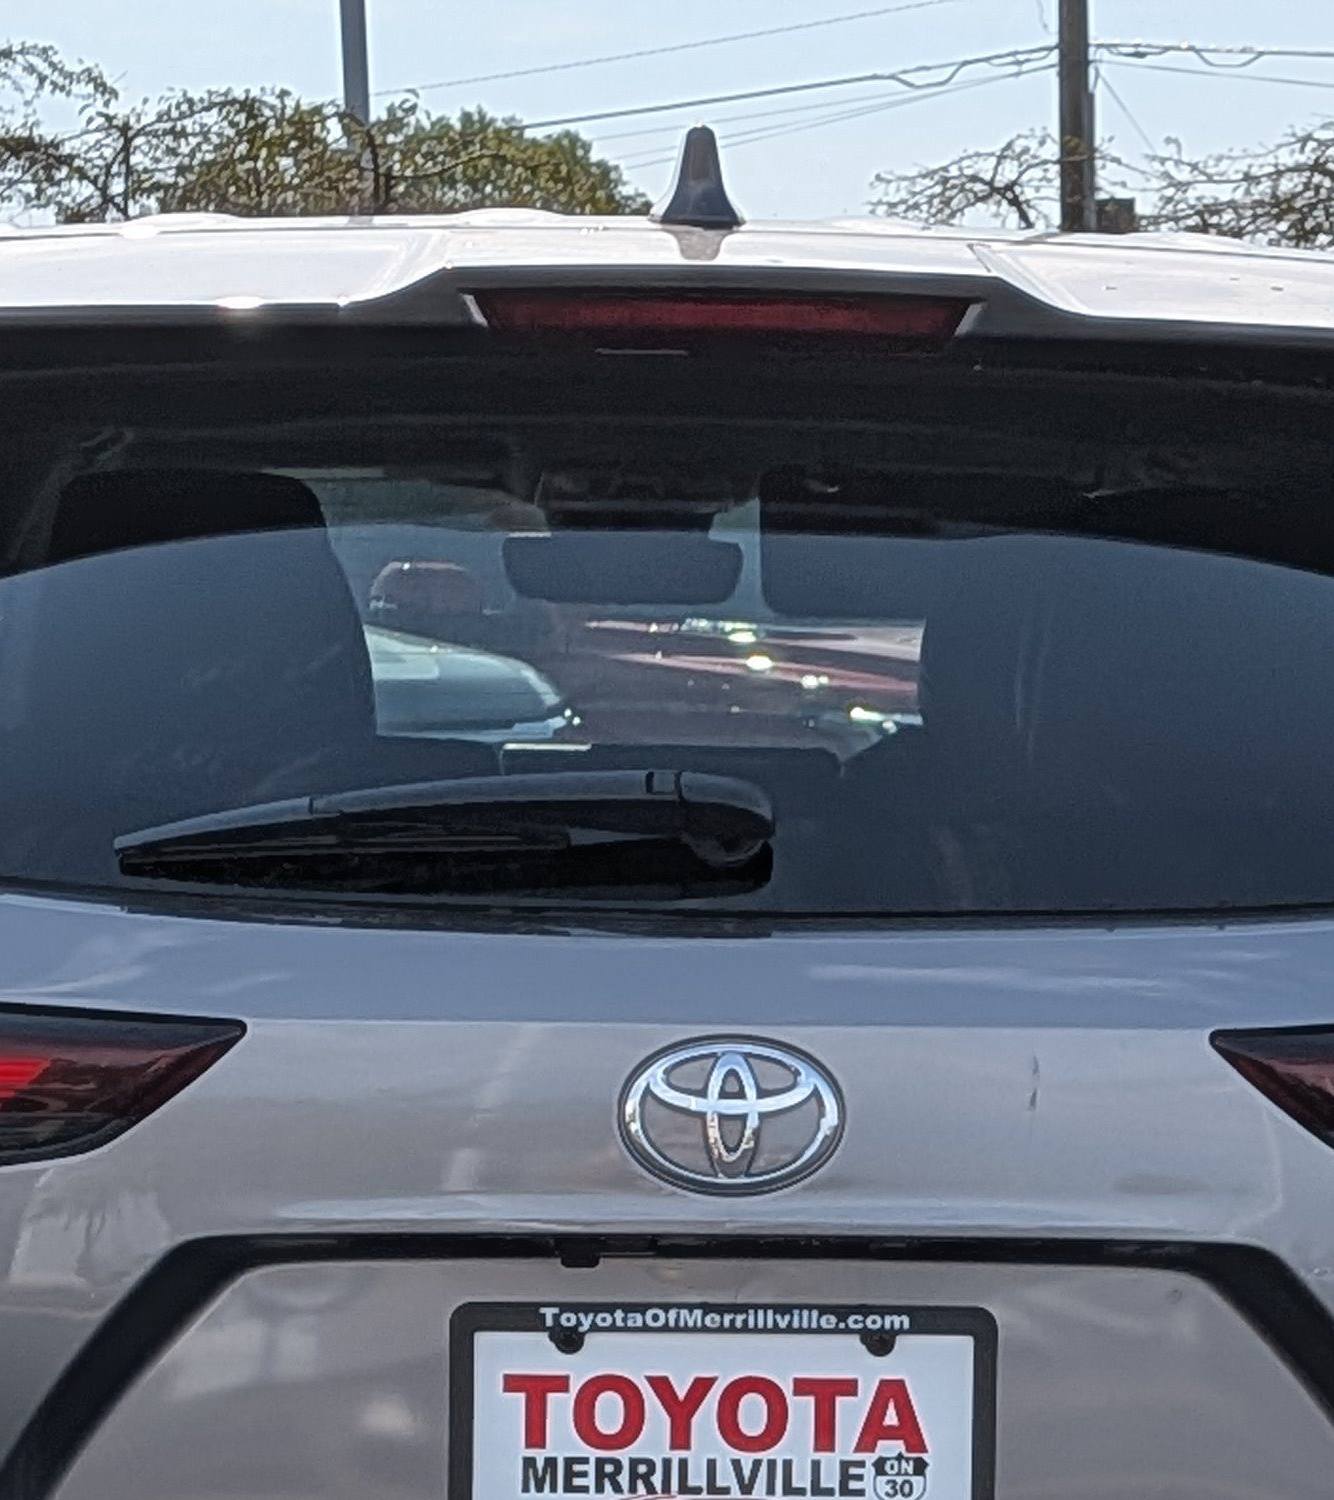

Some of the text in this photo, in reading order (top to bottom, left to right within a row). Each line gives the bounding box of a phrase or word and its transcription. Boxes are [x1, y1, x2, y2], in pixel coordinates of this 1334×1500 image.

[539, 1306, 910, 1332] ToyotaOfMerrillville.com
[502, 1373, 929, 1454] TOYOTA
[521, 1456, 866, 1497] MERRILLVILLE
[884, 1459, 914, 1475] ON
[884, 1479, 914, 1498] 30
